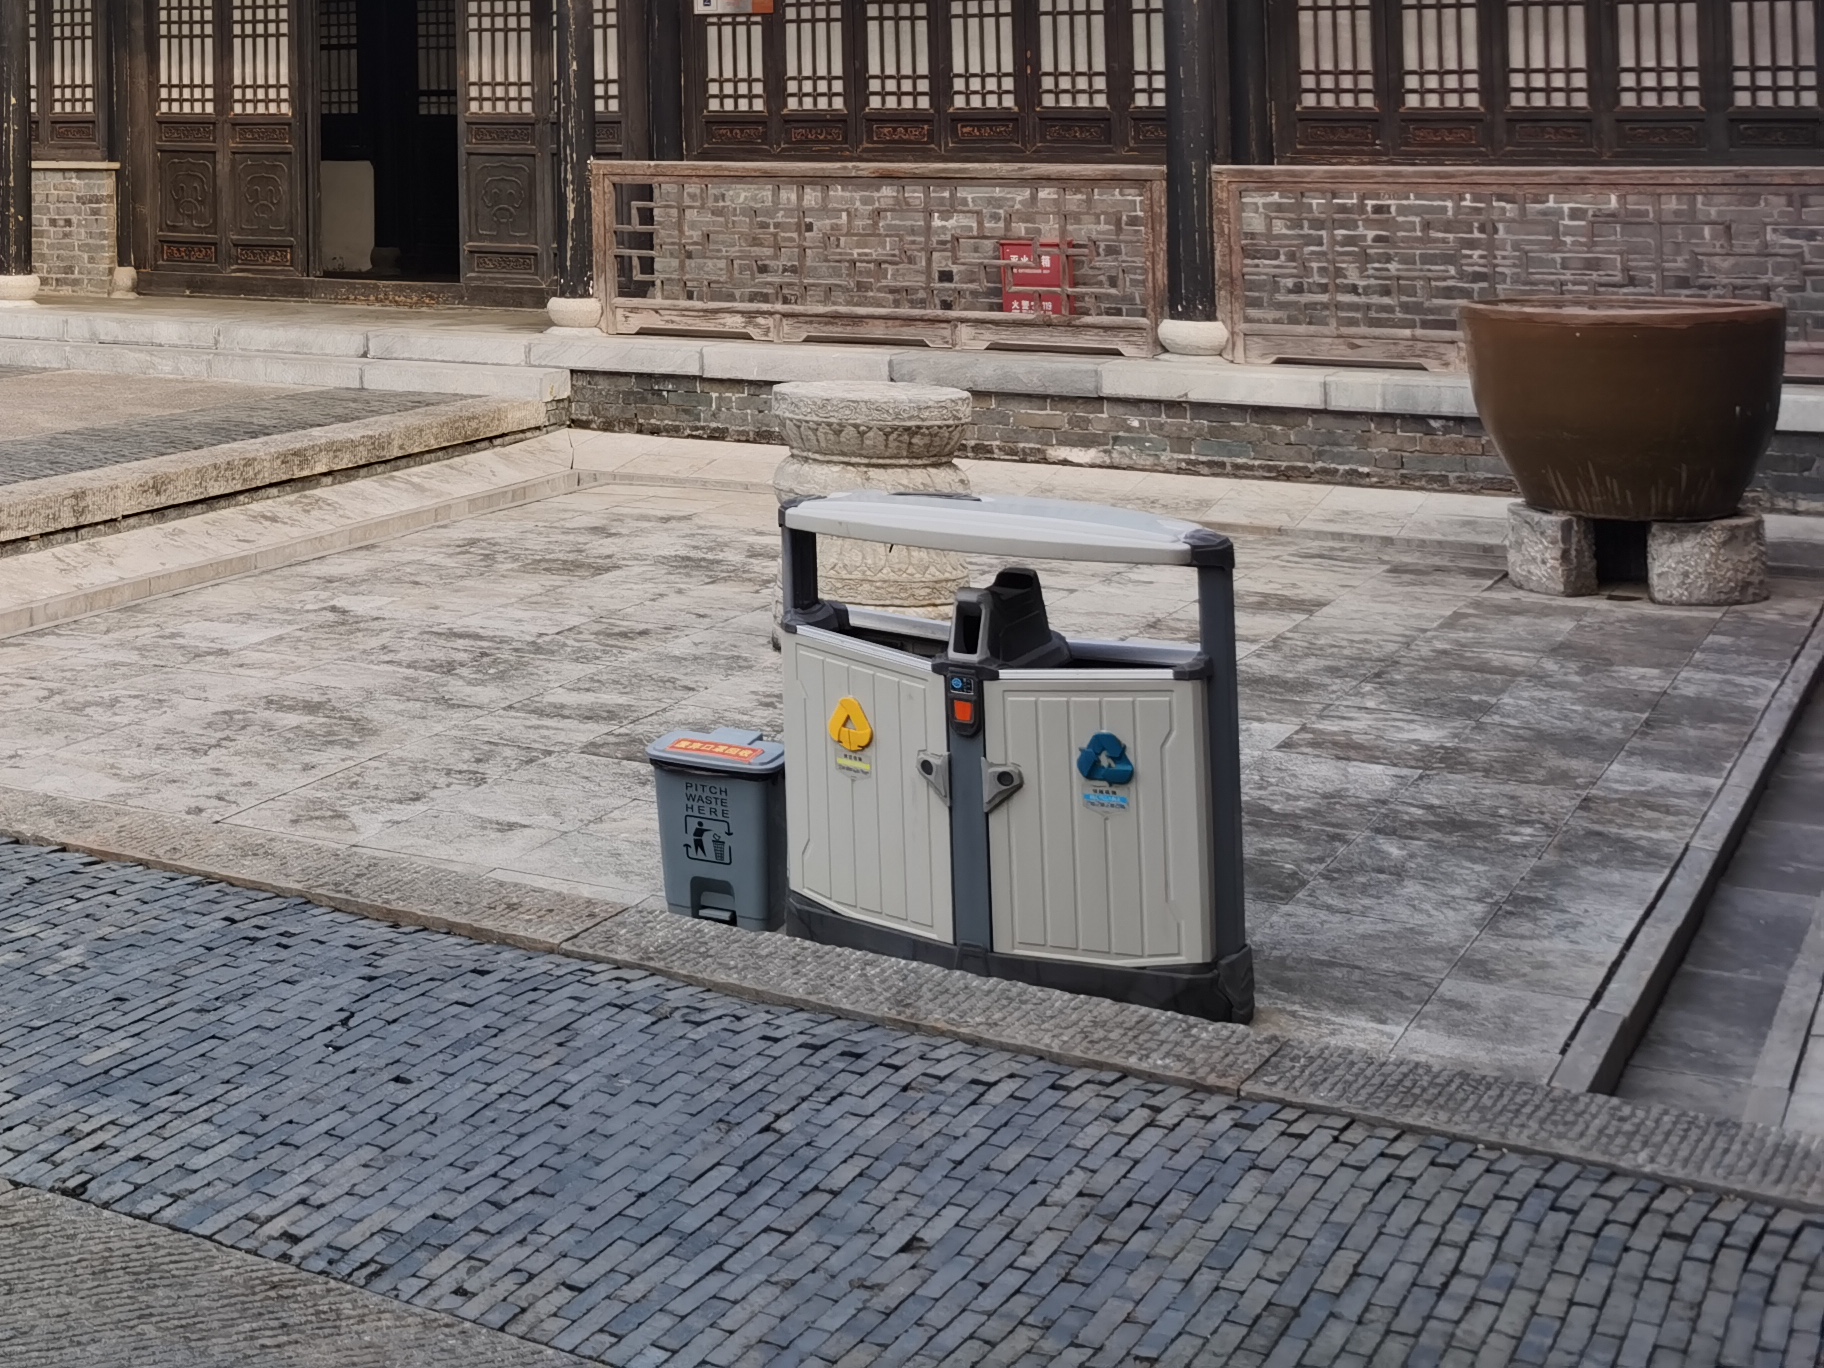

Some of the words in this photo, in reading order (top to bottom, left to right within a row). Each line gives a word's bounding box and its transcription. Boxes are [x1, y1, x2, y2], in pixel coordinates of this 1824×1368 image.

[685, 781, 728, 797] PITCH
[685, 792, 728, 808] WASTE
[685, 803, 730, 819] HERE
